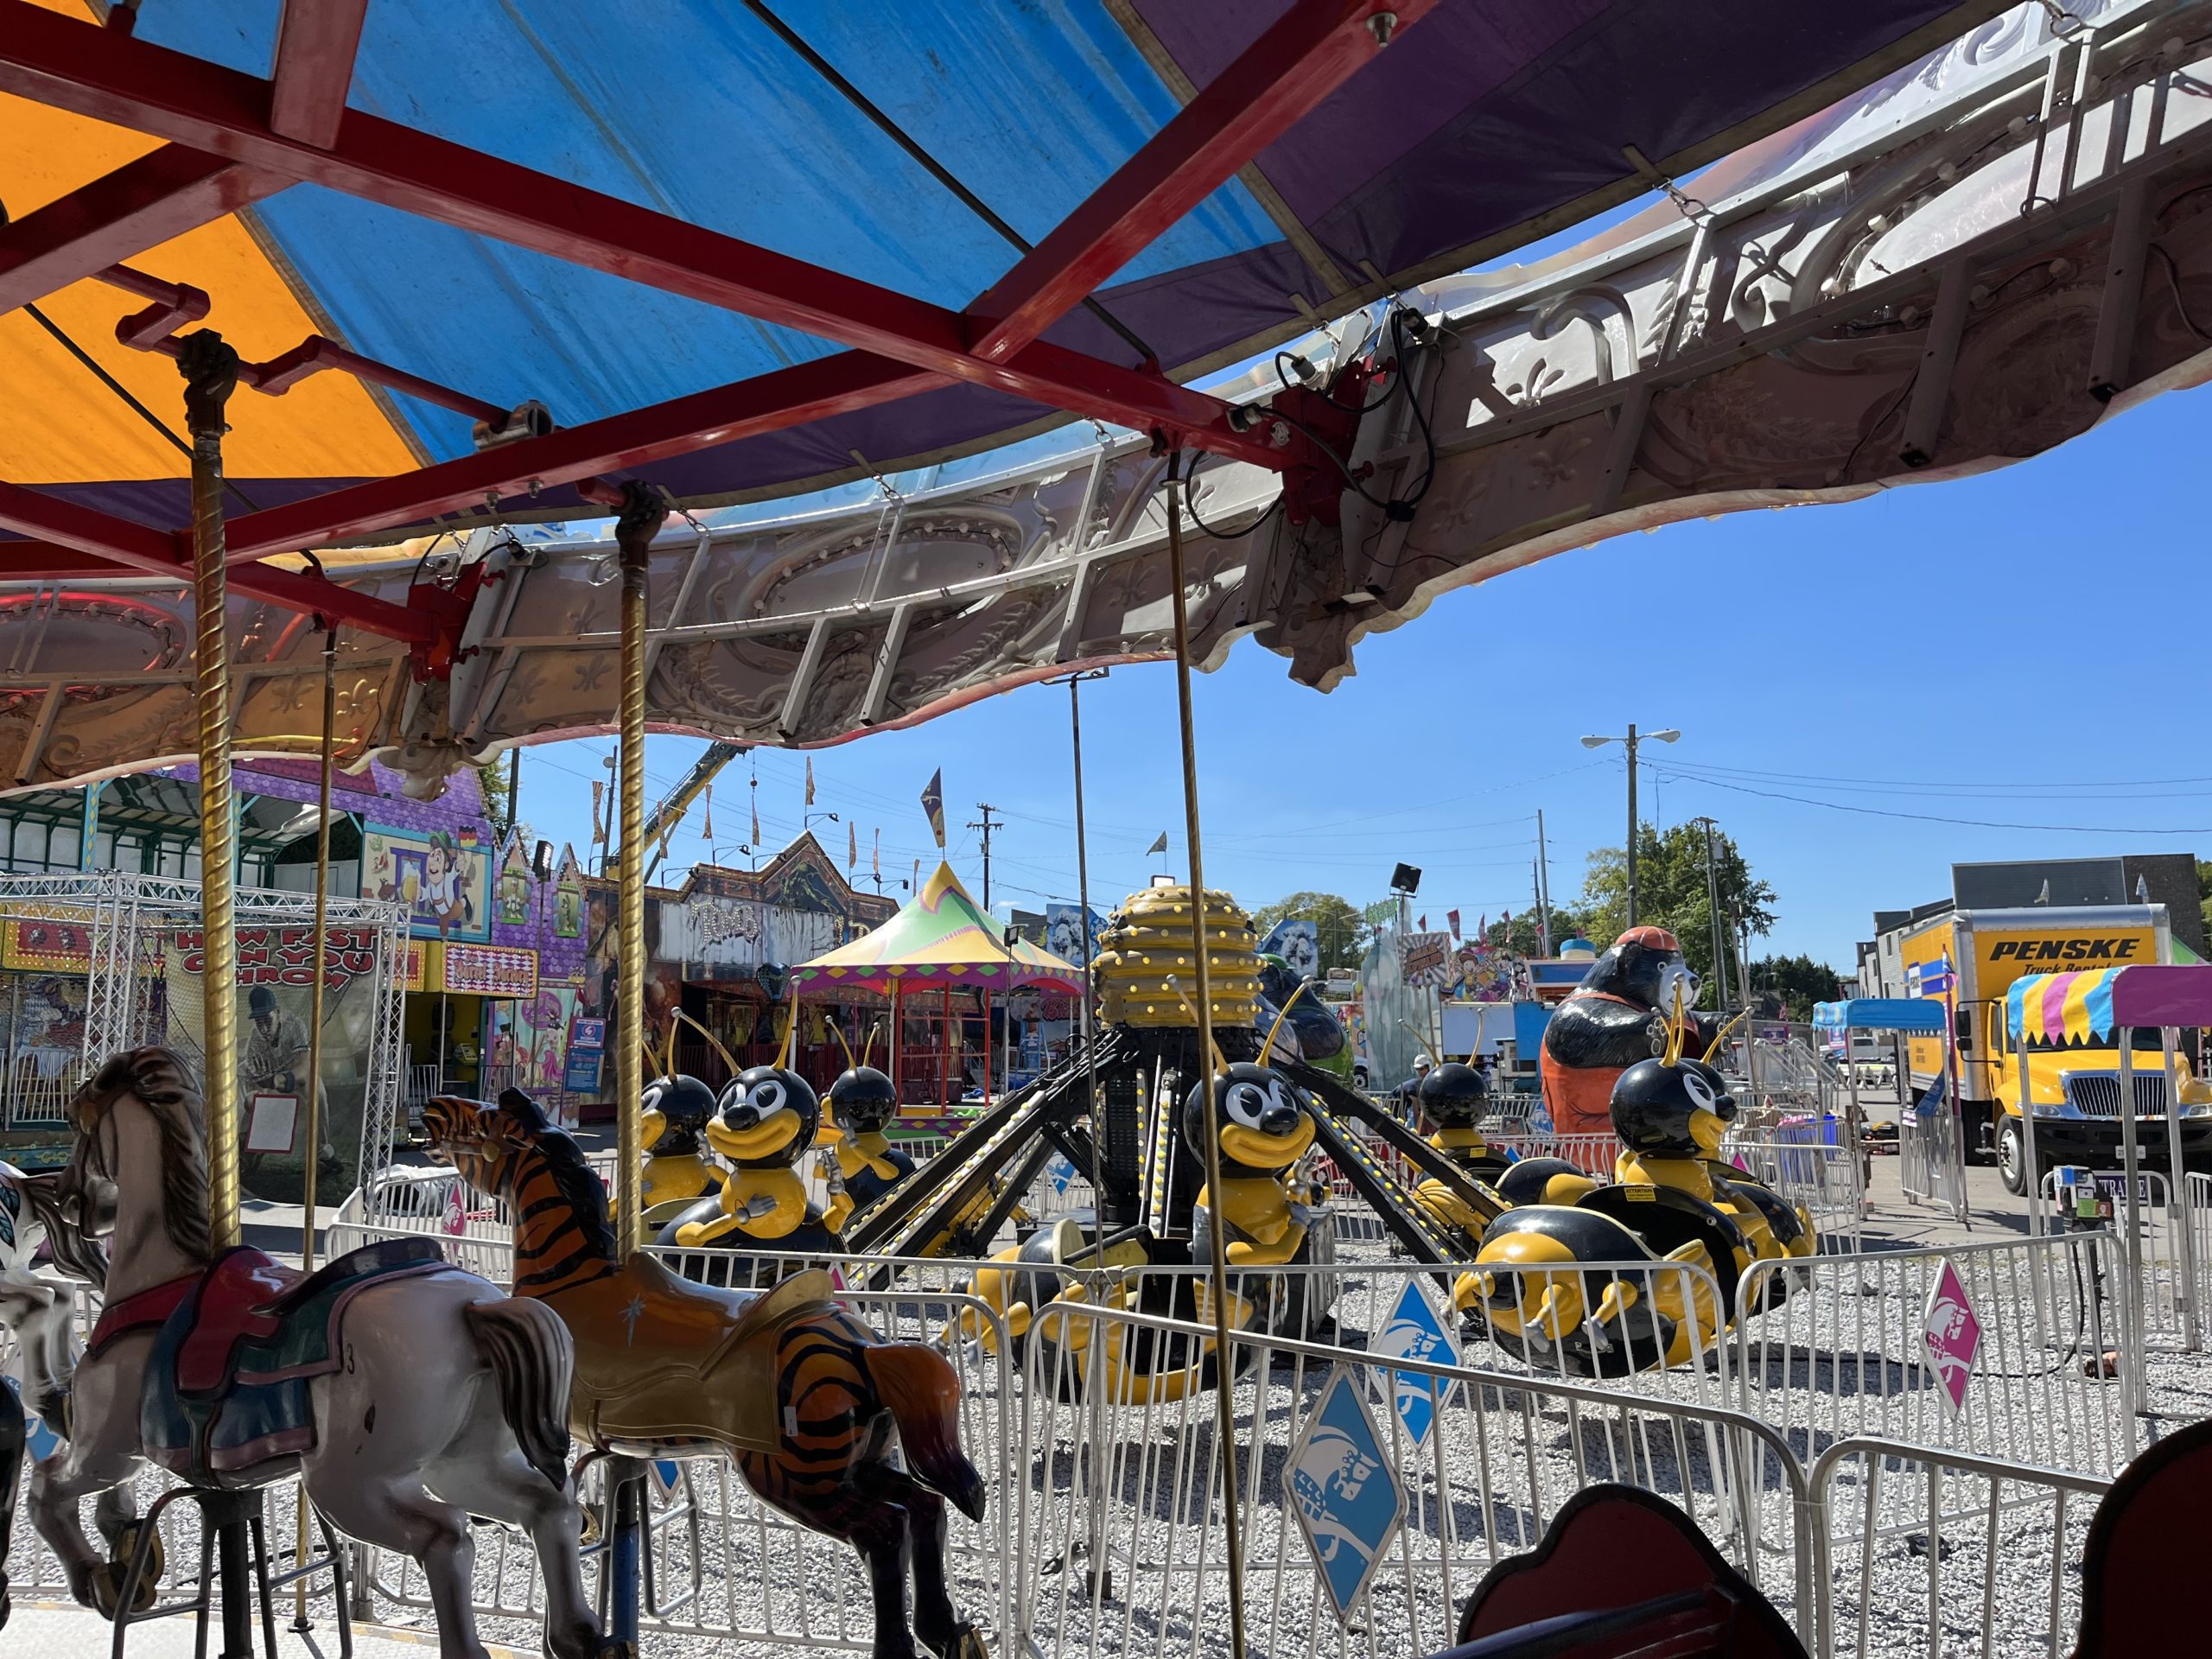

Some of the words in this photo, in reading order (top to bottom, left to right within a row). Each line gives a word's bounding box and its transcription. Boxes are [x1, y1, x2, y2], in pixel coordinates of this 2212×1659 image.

[175, 929, 270, 950] HW
[1989, 938, 2140, 961] PENSKE
[182, 948, 270, 974] CN
[276, 947, 374, 974] YOU
[2024, 963, 2061, 976] Truck
[235, 965, 350, 992] HROW
[2098, 1179, 2146, 1198] TRAE
[346, 1343, 355, 1375] 3
